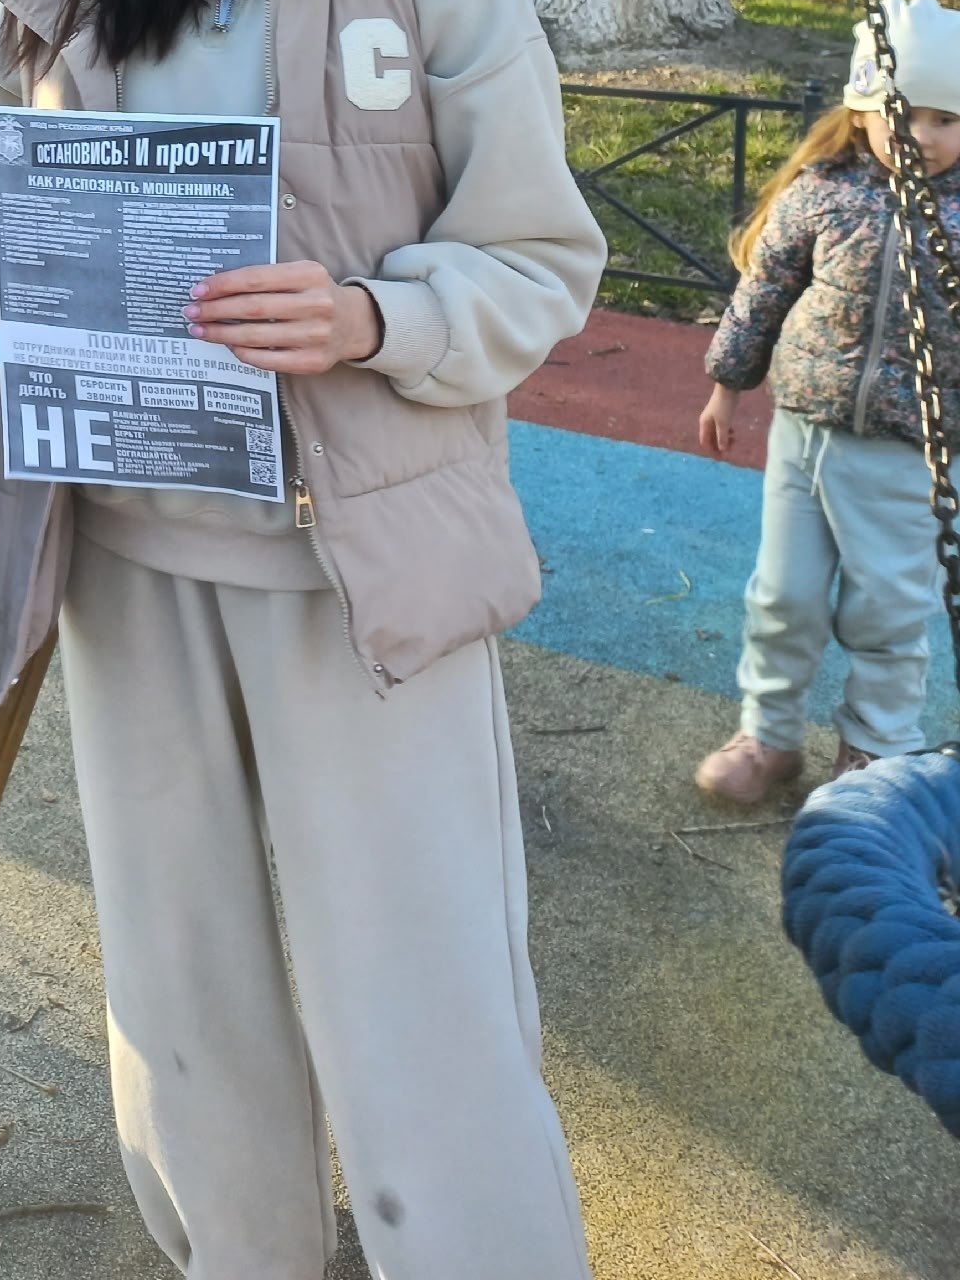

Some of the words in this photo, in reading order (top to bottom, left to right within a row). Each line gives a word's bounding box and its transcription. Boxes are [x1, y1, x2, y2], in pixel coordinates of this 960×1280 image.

[338, 17, 412, 111] C
[36, 140, 129, 166] ОСТАНОВИСЬ!
[135, 137, 150, 166] И
[28, 175, 54, 188] КАК
[55, 176, 140, 194] РАСПОЗНАТЬ
[142, 181, 235, 197] МОШЕННИКА:
[88, 333, 187, 355] ПОМНИТЕ!
[13, 341, 76, 356] СОТРУДНИКИ
[80, 348, 126, 361] ПОЛИЦИИ
[129, 354, 141, 364] НЕ
[144, 354, 184, 366] ЗВОНЯТ
[187, 358, 200, 368] ПО
[203, 359, 270, 379] ВИДЕОСВЯЗИ
[13, 353, 26, 363] НЕ
[28, 355, 91, 370] СУЩЕСТВУЕТ
[95, 362, 163, 376] БЕЗОПАСНЫХ
[166, 368, 208, 379] СЧЕТОВ!
[28, 371, 53, 384] ЧТО
[80, 379, 128, 392] СБРОСИТЬ
[19, 384, 67, 399] ДЕЛАТЬ
[86, 392, 124, 403] ЗВОНОК
[141, 385, 196, 397] ПОЗВОНИТЬ
[206, 390, 260, 405] ПОЗВОНИТЬ
[144, 397, 195, 407] БЛИЗКОМУ
[207, 400, 214, 408] В
[215, 402, 260, 416] ПОЛИЦИЮ
[20, 404, 115, 472] НЕ
